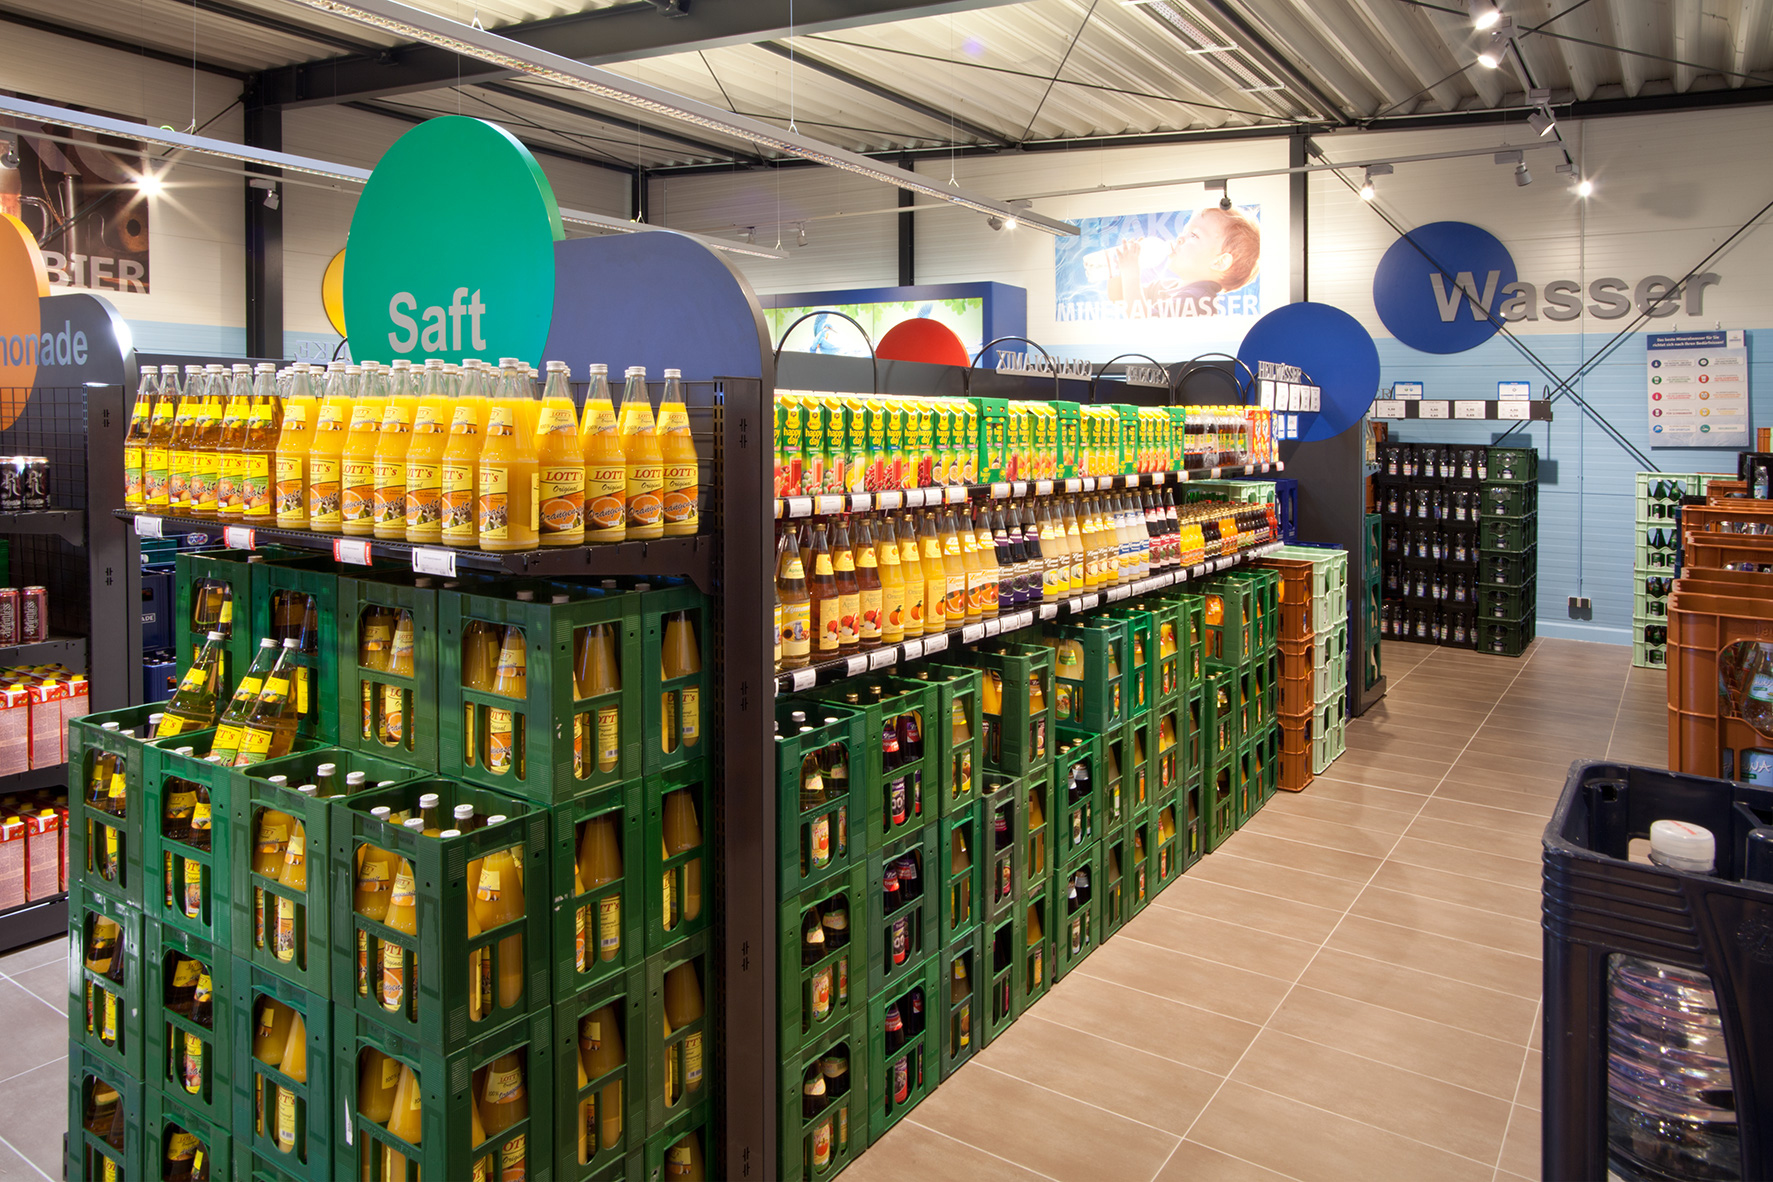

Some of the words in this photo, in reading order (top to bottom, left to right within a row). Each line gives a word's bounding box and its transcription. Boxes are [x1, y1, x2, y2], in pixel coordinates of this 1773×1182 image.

[40, 250, 147, 294] BIER
[1429, 270, 1722, 323] Wasser
[1056, 294, 1259, 322] MINERALWASSER
[388, 287, 486, 354] Saft
[784, 427, 801, 439] happy
[805, 428, 822, 439] happy
[827, 428, 844, 439] happy
[850, 428, 865, 439] happy
[787, 435, 799, 446] day
[809, 435, 819, 447] day
[831, 436, 842, 447] day
[853, 436, 863, 446] day
[546, 471, 583, 482] LOTT's
[553, 484, 578, 494] Original
[669, 480, 692, 489] Original
